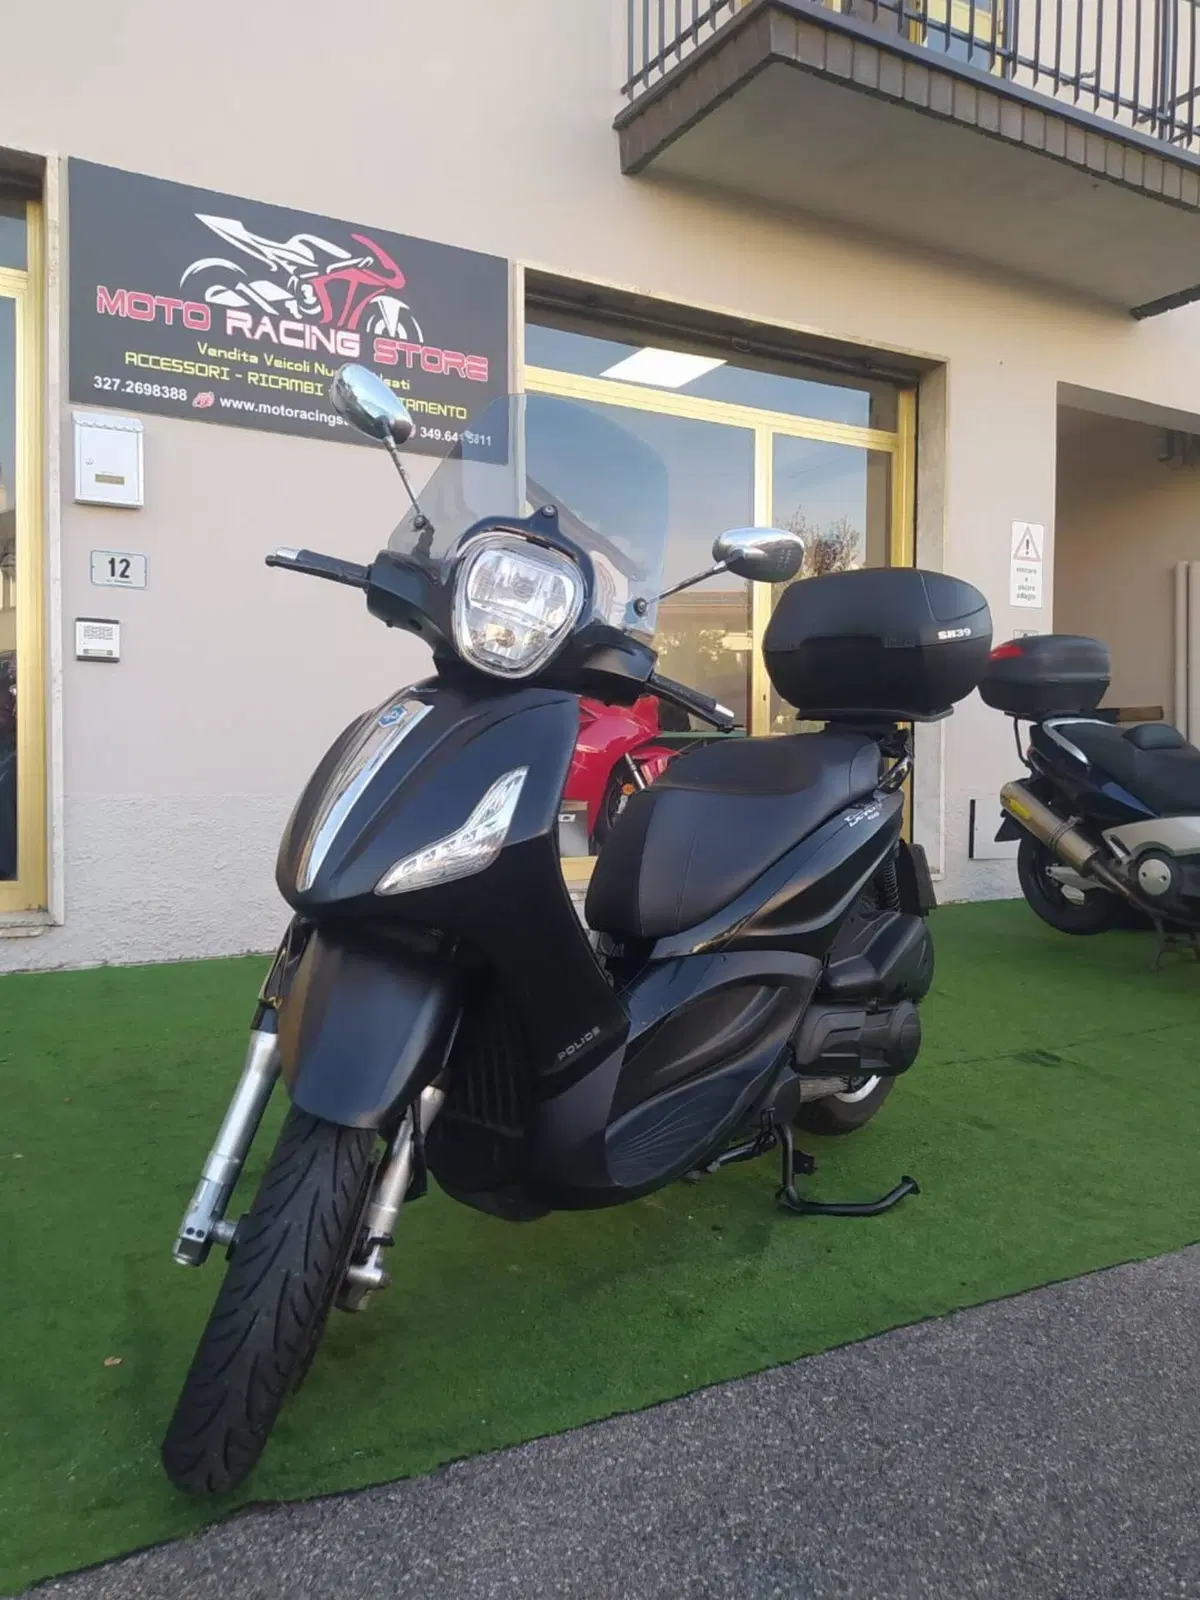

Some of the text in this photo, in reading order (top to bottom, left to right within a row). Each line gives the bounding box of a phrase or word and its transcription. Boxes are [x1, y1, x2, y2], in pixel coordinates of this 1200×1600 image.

[97, 285, 488, 382] MOTO RACING STORE
[125, 351, 230, 380] ACCESSORI
[247, 372, 325, 396] RICAMBI
[197, 341, 258, 364] Vendita
[264, 353, 310, 373] Veicoli
[380, 374, 411, 390] sati
[93, 375, 188, 401] 327.2698388
[219, 397, 349, 427] www.motoracings
[108, 557, 130, 578] 12
